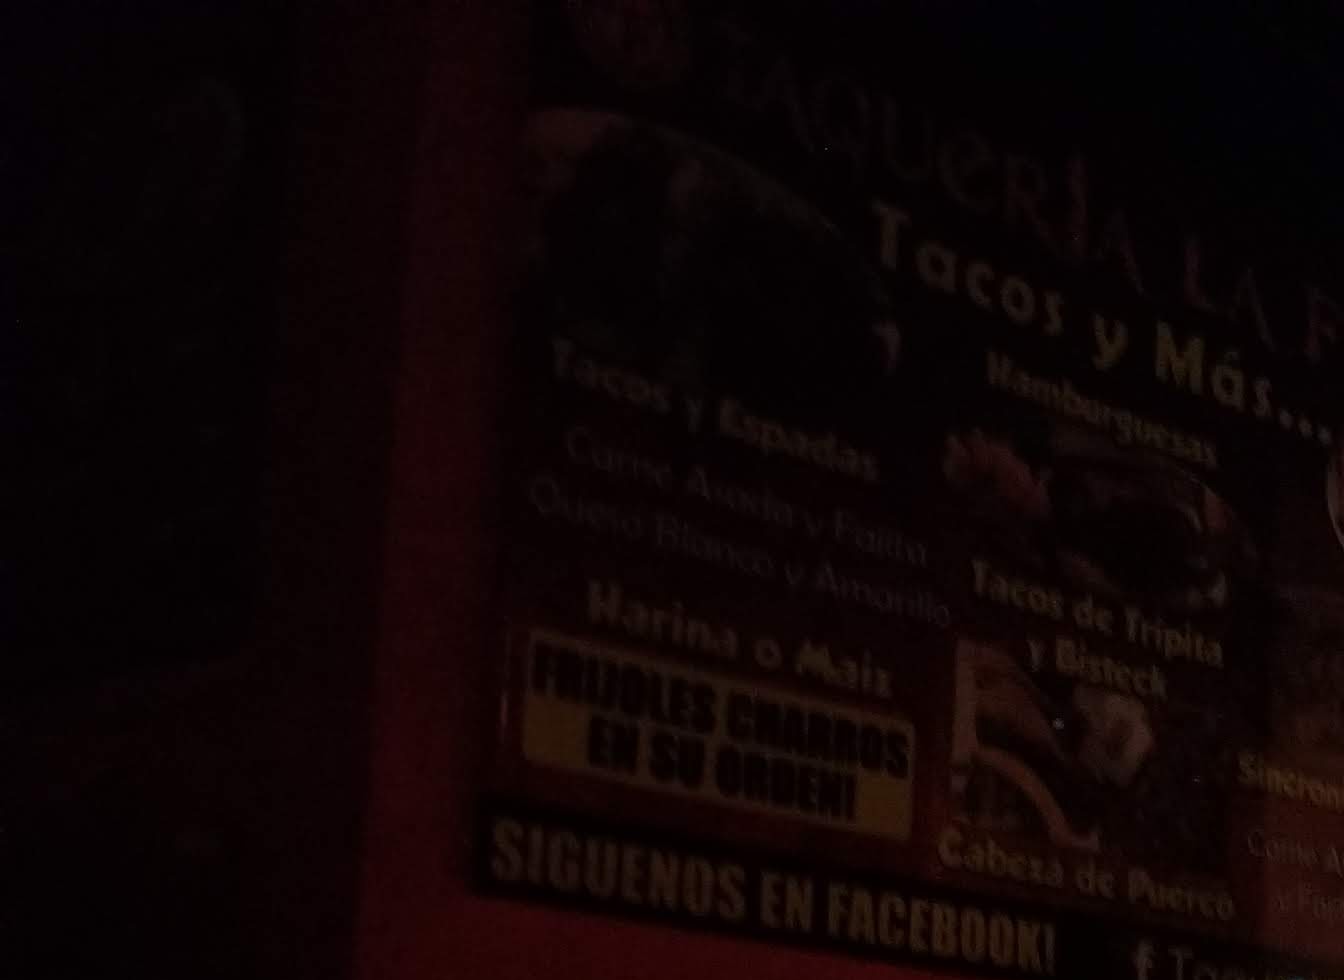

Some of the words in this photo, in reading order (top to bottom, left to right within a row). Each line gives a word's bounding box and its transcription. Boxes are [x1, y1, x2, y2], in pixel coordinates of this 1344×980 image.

[872, 197, 1064, 335] Tacos
[1091, 314, 1128, 371] y
[1184, 233, 1276, 352] LA
[551, 334, 672, 415] Tacos
[718, 396, 880, 482] Espadas
[985, 347, 1219, 470] Hamburguesas
[586, 579, 740, 660] Harina
[753, 637, 783, 670] o
[653, 512, 774, 579] Blanco
[815, 562, 951, 629] Amarillo
[972, 557, 1065, 622] Tacos
[1073, 600, 1115, 639] de
[532, 642, 718, 735] FRIJOLES
[725, 686, 911, 781] CHARROS
[586, 714, 641, 773] EN
[648, 730, 706, 790] SU
[490, 818, 748, 922] SIGUENOS
[760, 871, 814, 931] EN
[826, 883, 1057, 976] FACEBOOK!
[938, 822, 1067, 893] Cabeza
[1075, 852, 1116, 902] de
[1126, 866, 1237, 924] Puerco
